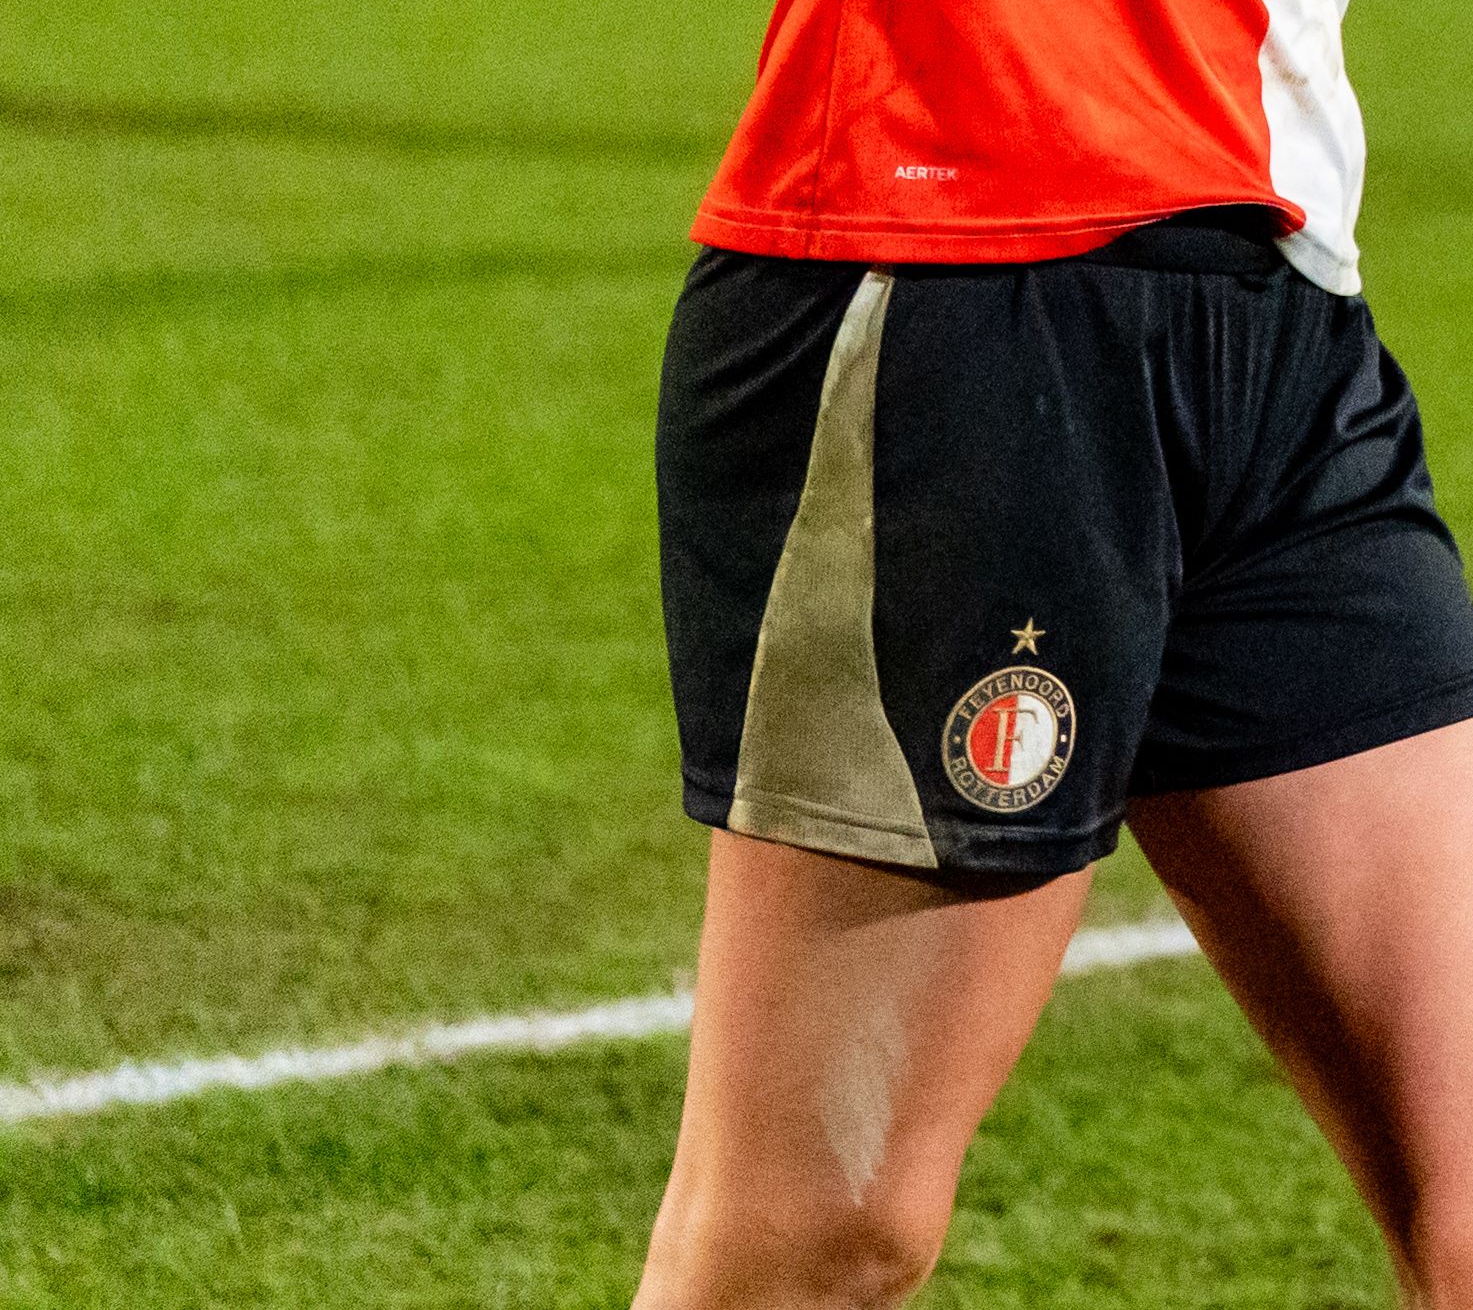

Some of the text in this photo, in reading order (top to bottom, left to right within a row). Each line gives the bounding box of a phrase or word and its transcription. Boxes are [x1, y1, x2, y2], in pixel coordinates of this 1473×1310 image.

[895, 165, 958, 181] AERTEK
[958, 674, 1070, 719] FEYENOORD
[985, 707, 1039, 773] F
[951, 755, 1065, 807] ROTTERDAM
